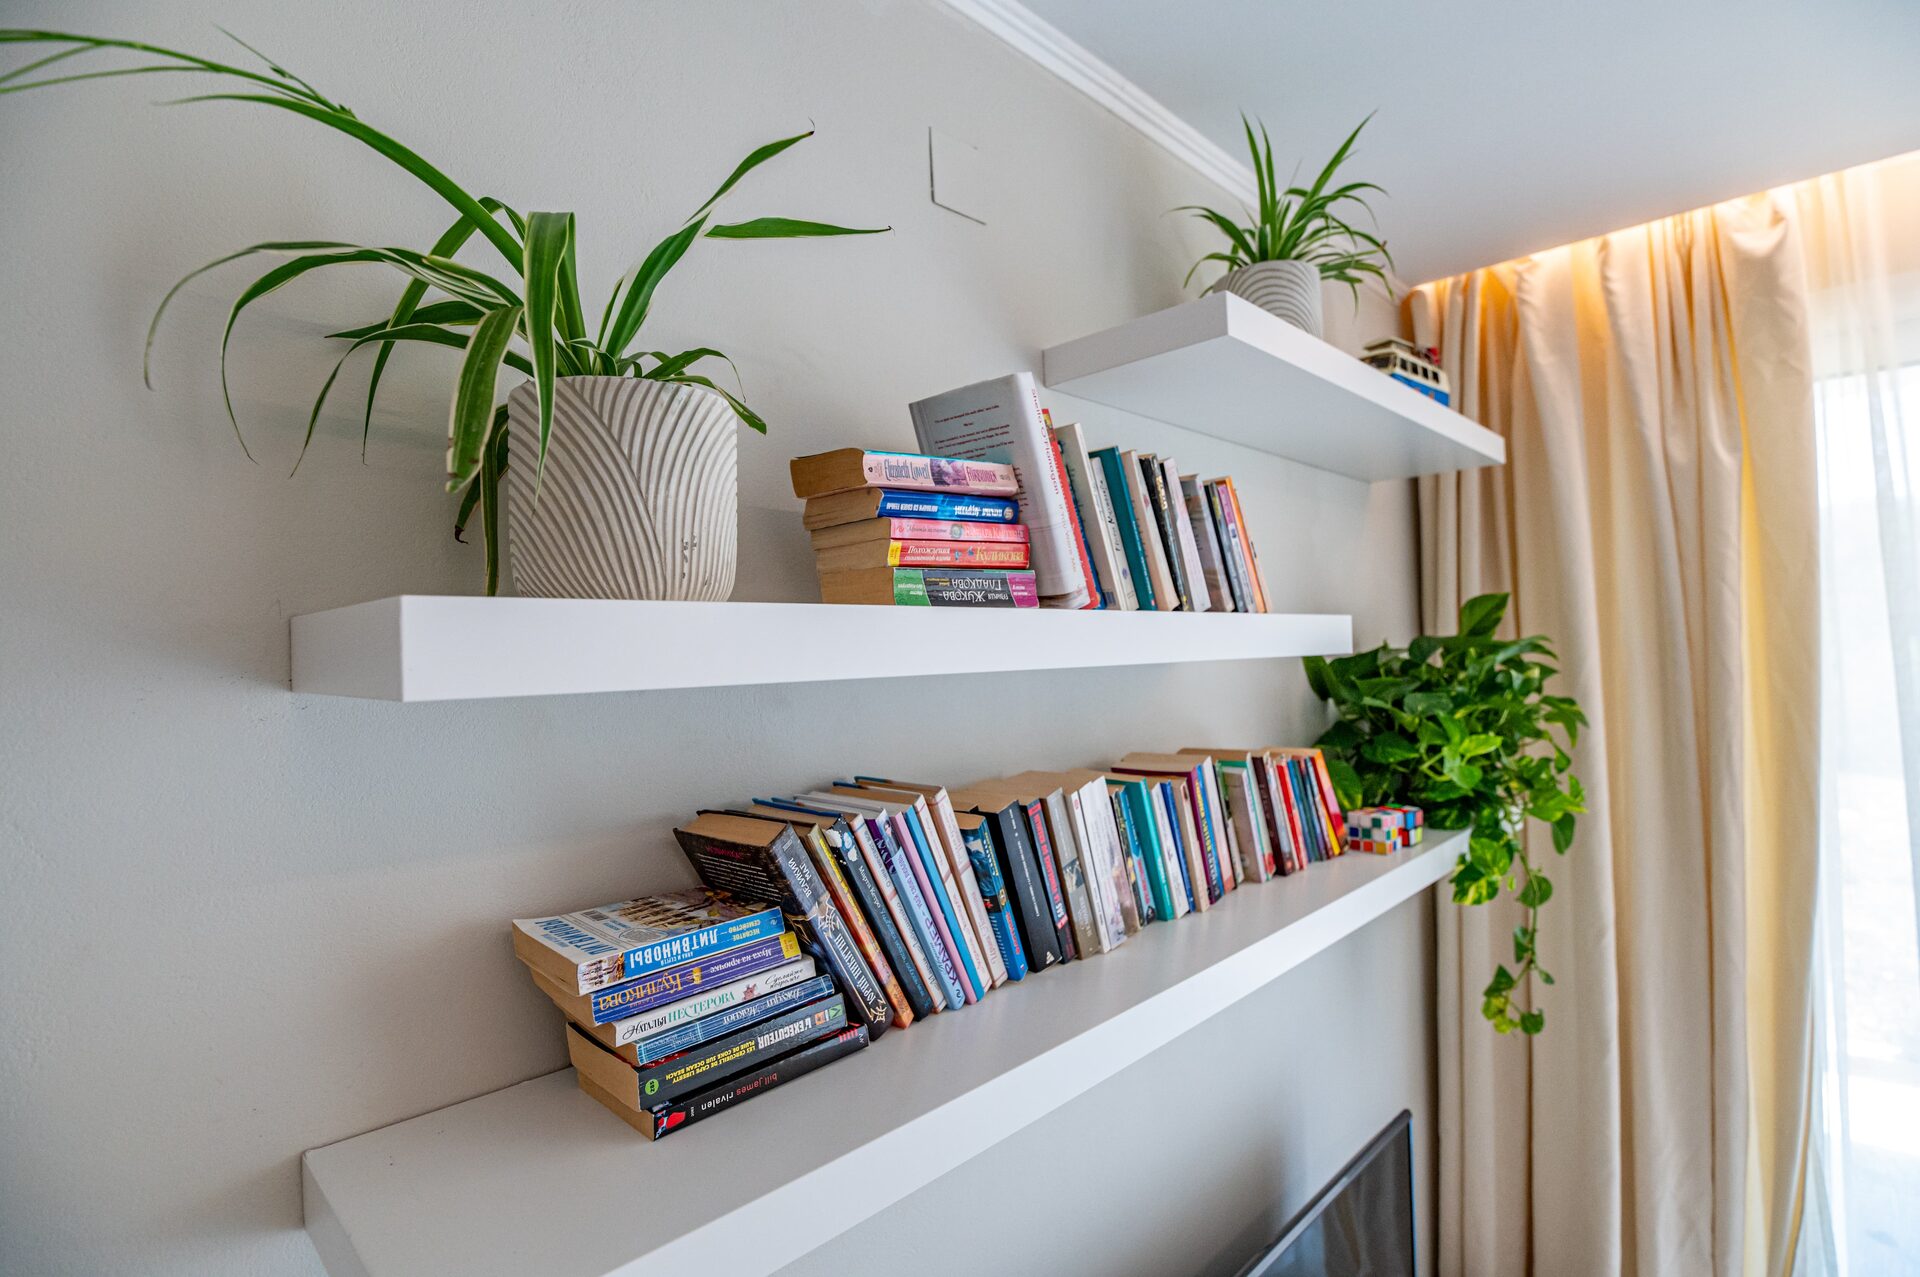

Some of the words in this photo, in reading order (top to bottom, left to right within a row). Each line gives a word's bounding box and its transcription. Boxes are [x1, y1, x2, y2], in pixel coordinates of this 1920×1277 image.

[883, 457, 909, 481] Elizabeth
[911, 461, 932, 480] Lowell
[975, 546, 1023, 561] Куликова
[785, 856, 813, 898] ВЕЛИКИЙ
[798, 861, 812, 880] МАГ
[626, 928, 720, 968] ЛИТВИНОВЫ
[751, 946, 773, 961] Муха
[831, 932, 863, 979] НИКИТИН
[922, 915, 959, 986] КРАМЕР
[708, 956, 741, 974] крючке
[740, 954, 751, 962] на
[597, 970, 684, 1012] Куликова
[853, 974, 878, 1005] ЮРИЙ
[739, 1039, 756, 1050] PLUIE
[745, 1045, 756, 1053] LES
[704, 1055, 717, 1064] SUR
[709, 1060, 718, 1068] DE
[717, 1049, 746, 1064] CERCUEILS
[685, 1060, 706, 1071] OCEAN
[694, 1063, 710, 1074] CAPE
[664, 1067, 686, 1080] BEACH
[670, 1070, 696, 1084] LIBERTY
[763, 1071, 778, 1085] bill
[734, 1076, 765, 1097] james
[699, 1090, 736, 1112] rivalen
